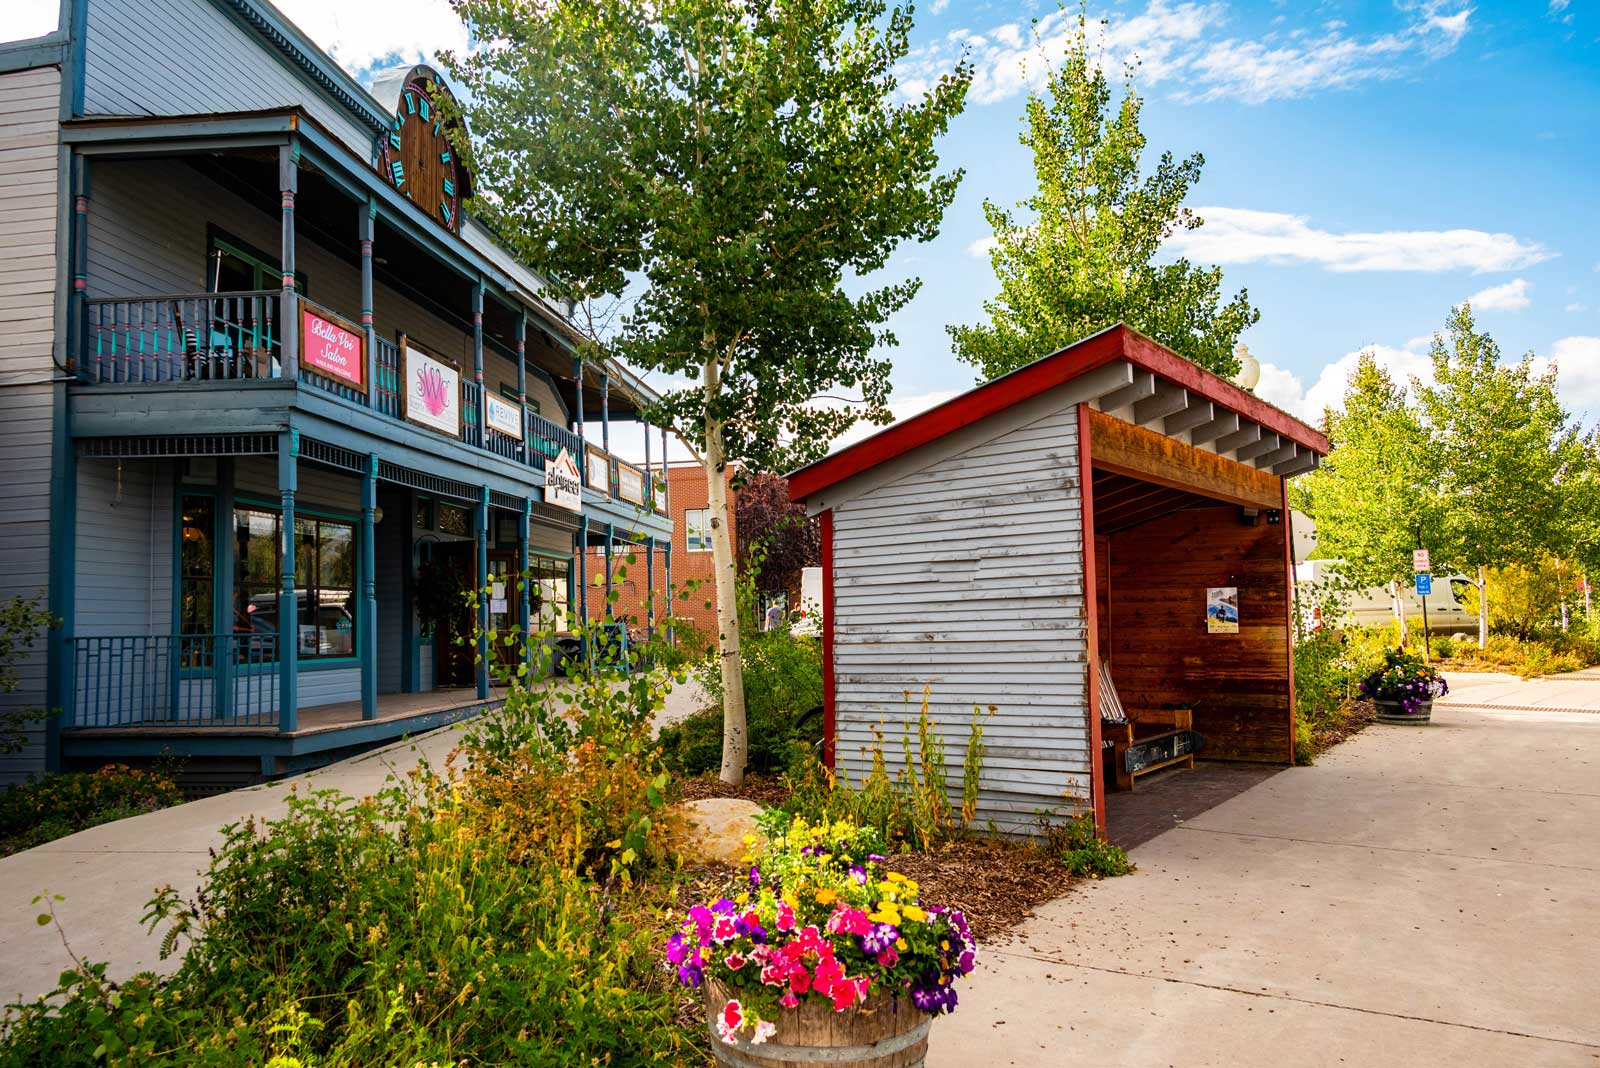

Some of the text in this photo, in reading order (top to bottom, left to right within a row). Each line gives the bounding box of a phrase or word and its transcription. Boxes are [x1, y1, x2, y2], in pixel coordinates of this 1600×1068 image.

[311, 318, 354, 351] Bella Voi
[320, 343, 347, 366] Salon
[495, 403, 519, 426] REVIVE
